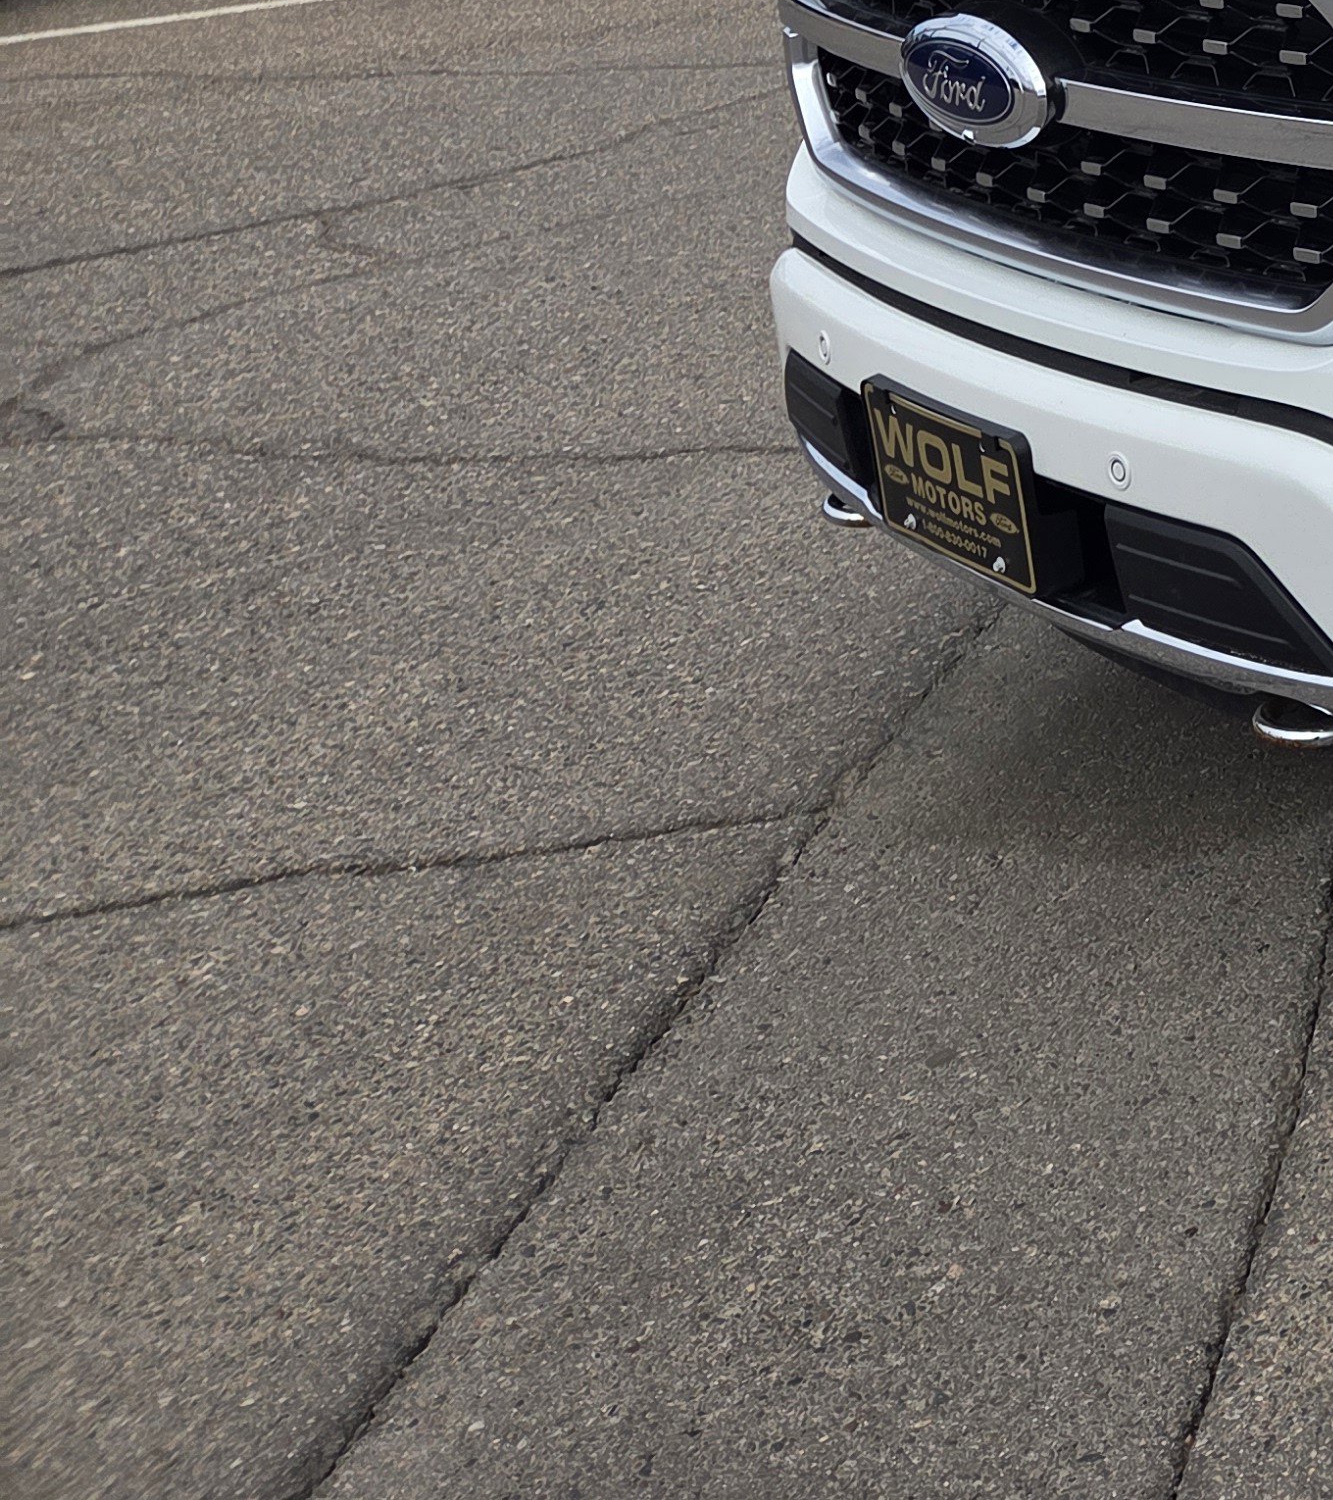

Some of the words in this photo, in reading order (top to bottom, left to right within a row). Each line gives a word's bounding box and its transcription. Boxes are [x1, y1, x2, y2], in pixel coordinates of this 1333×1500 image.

[922, 49, 986, 113] Ford
[874, 407, 1011, 505] WOLF
[911, 472, 987, 527] MOTORS
